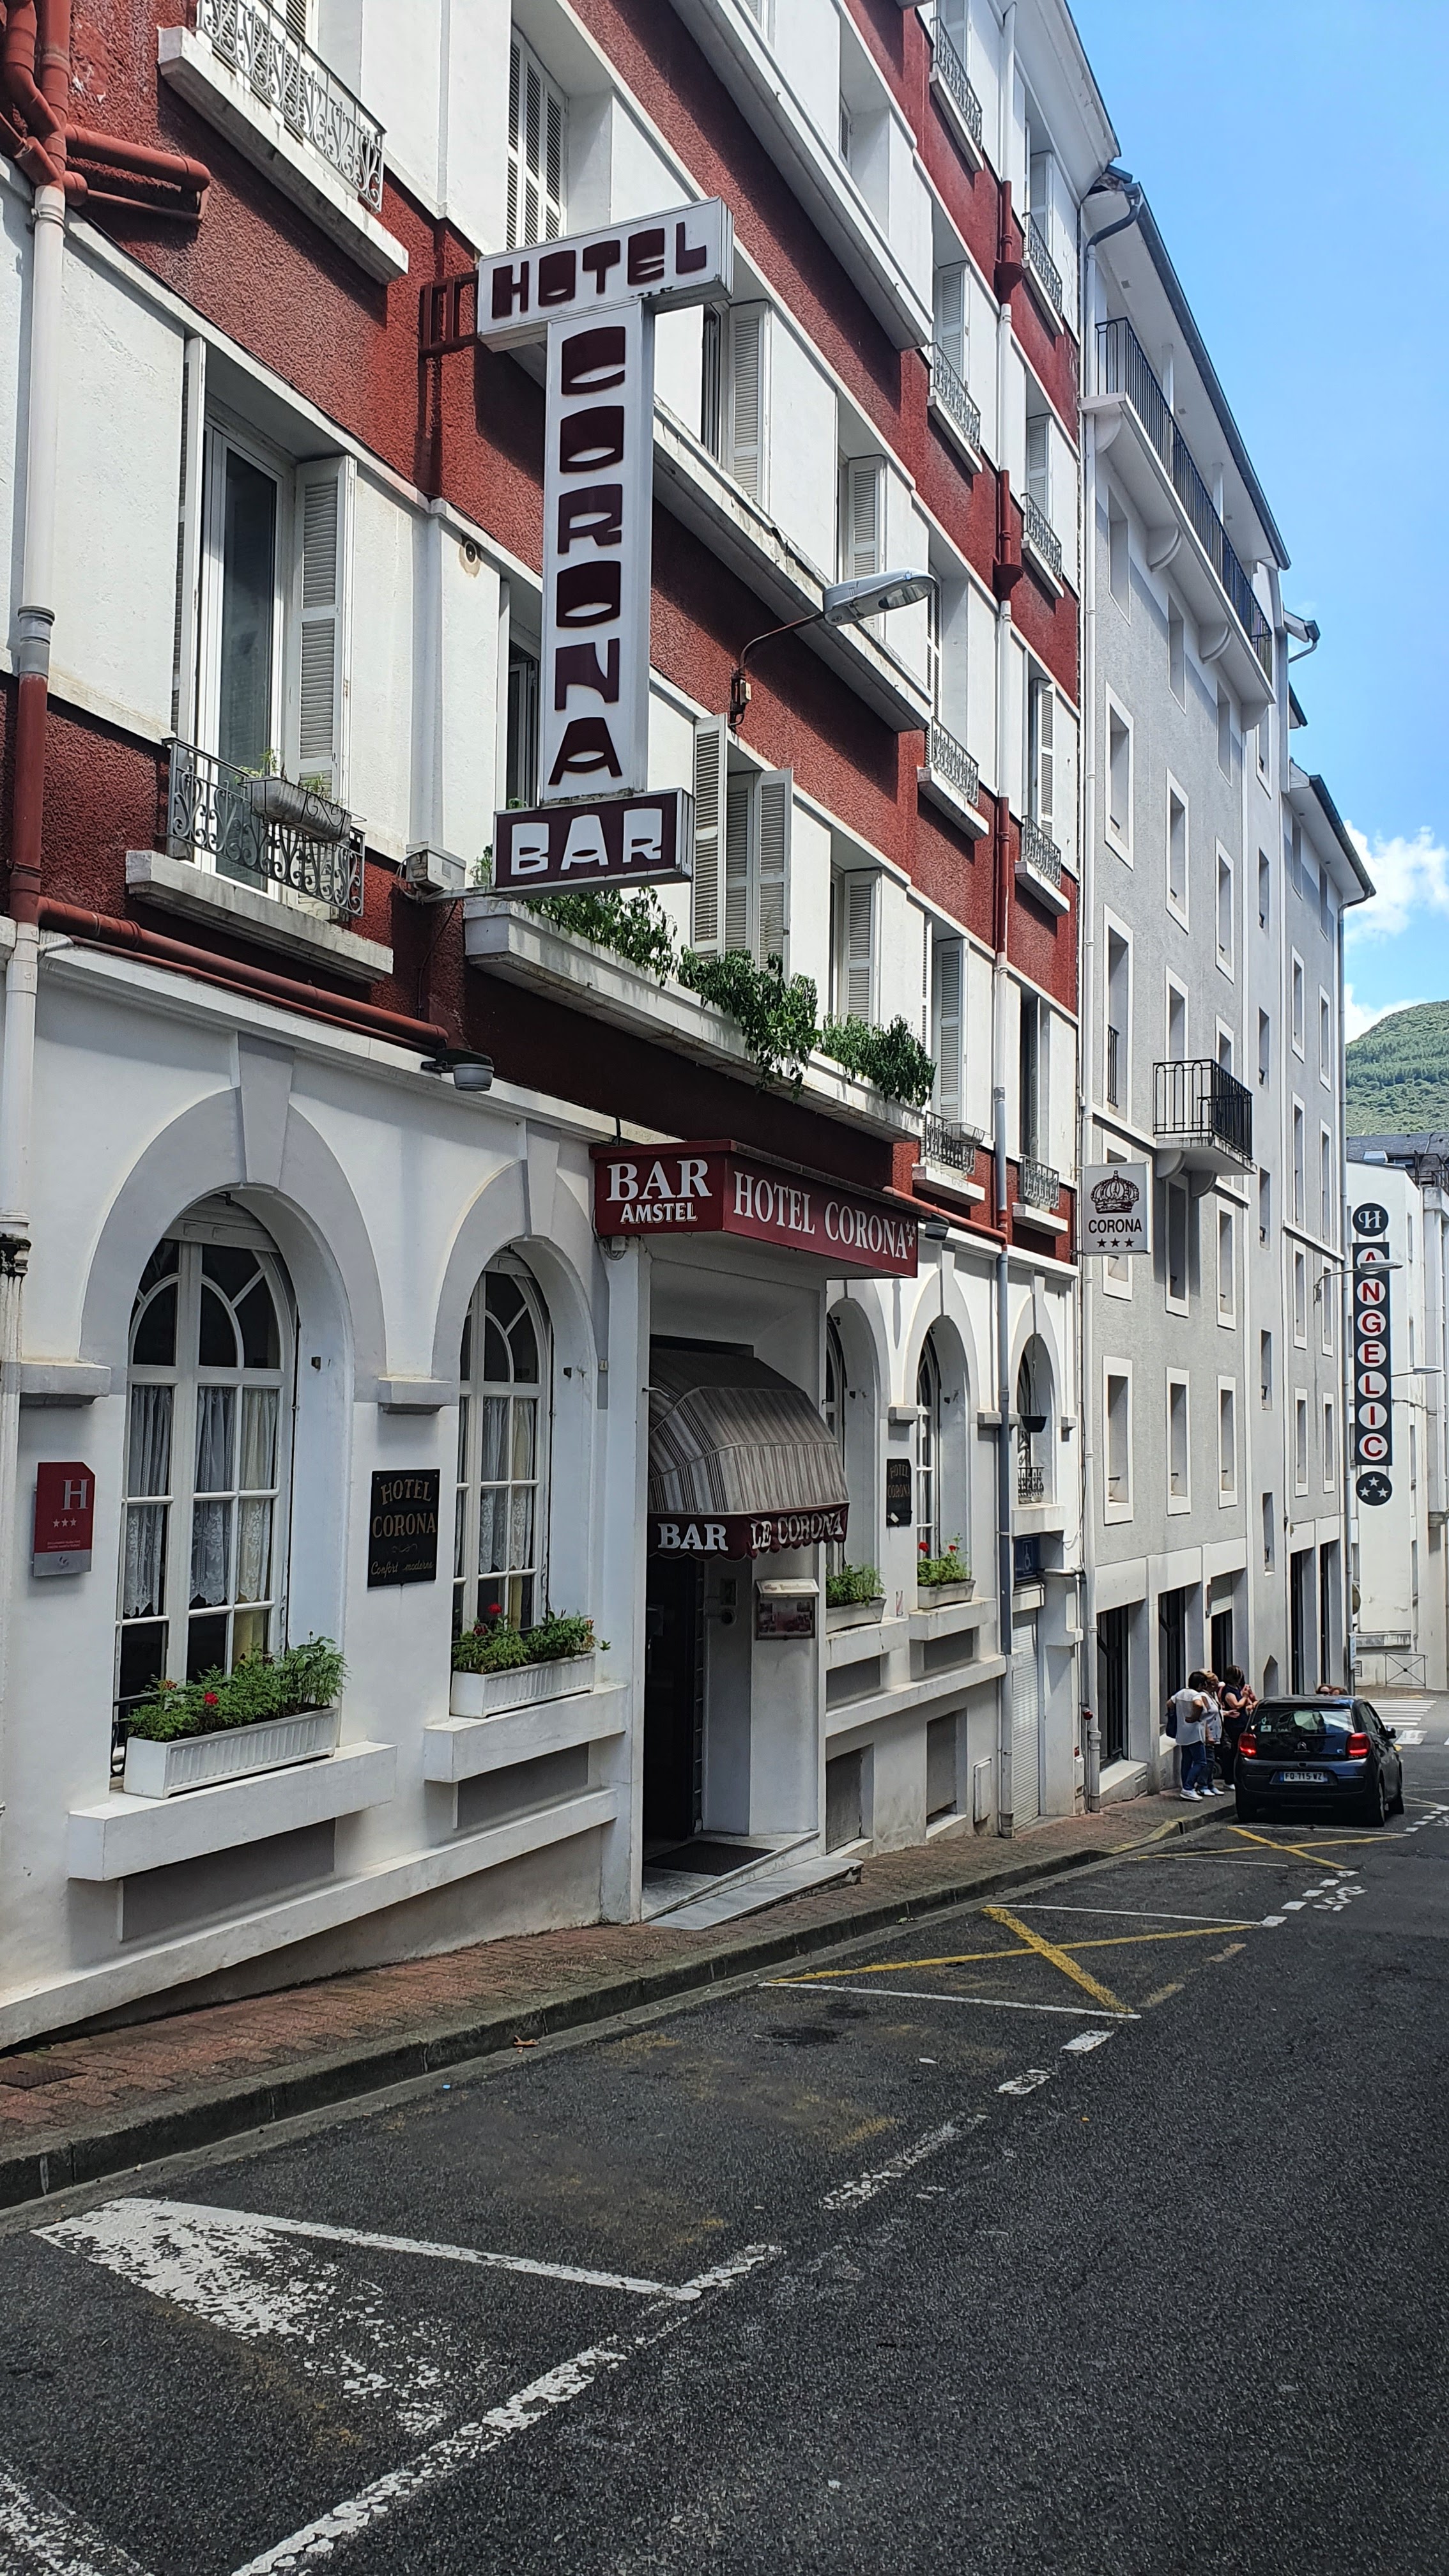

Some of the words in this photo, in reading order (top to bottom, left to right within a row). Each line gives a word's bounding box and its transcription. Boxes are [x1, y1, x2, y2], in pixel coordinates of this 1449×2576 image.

[491, 221, 707, 319] HOTEL
[548, 325, 626, 786] CORONA
[511, 807, 662, 876] BAR
[606, 1159, 712, 1202] BAR
[620, 1202, 698, 1223] AMSTEL
[733, 1170, 816, 1236] HOTEL
[824, 1201, 908, 1261] CORONA
[1088, 1218, 1142, 1234] CORONA
[61, 1478, 89, 1510] H
[381, 1479, 433, 1505] HOTEL
[372, 1512, 436, 1538] CORONA
[657, 1523, 728, 1551] BAR
[750, 1521, 772, 1549] LE
[778, 1513, 844, 1544] CORONA
[371, 1560, 399, 1579] Confort
